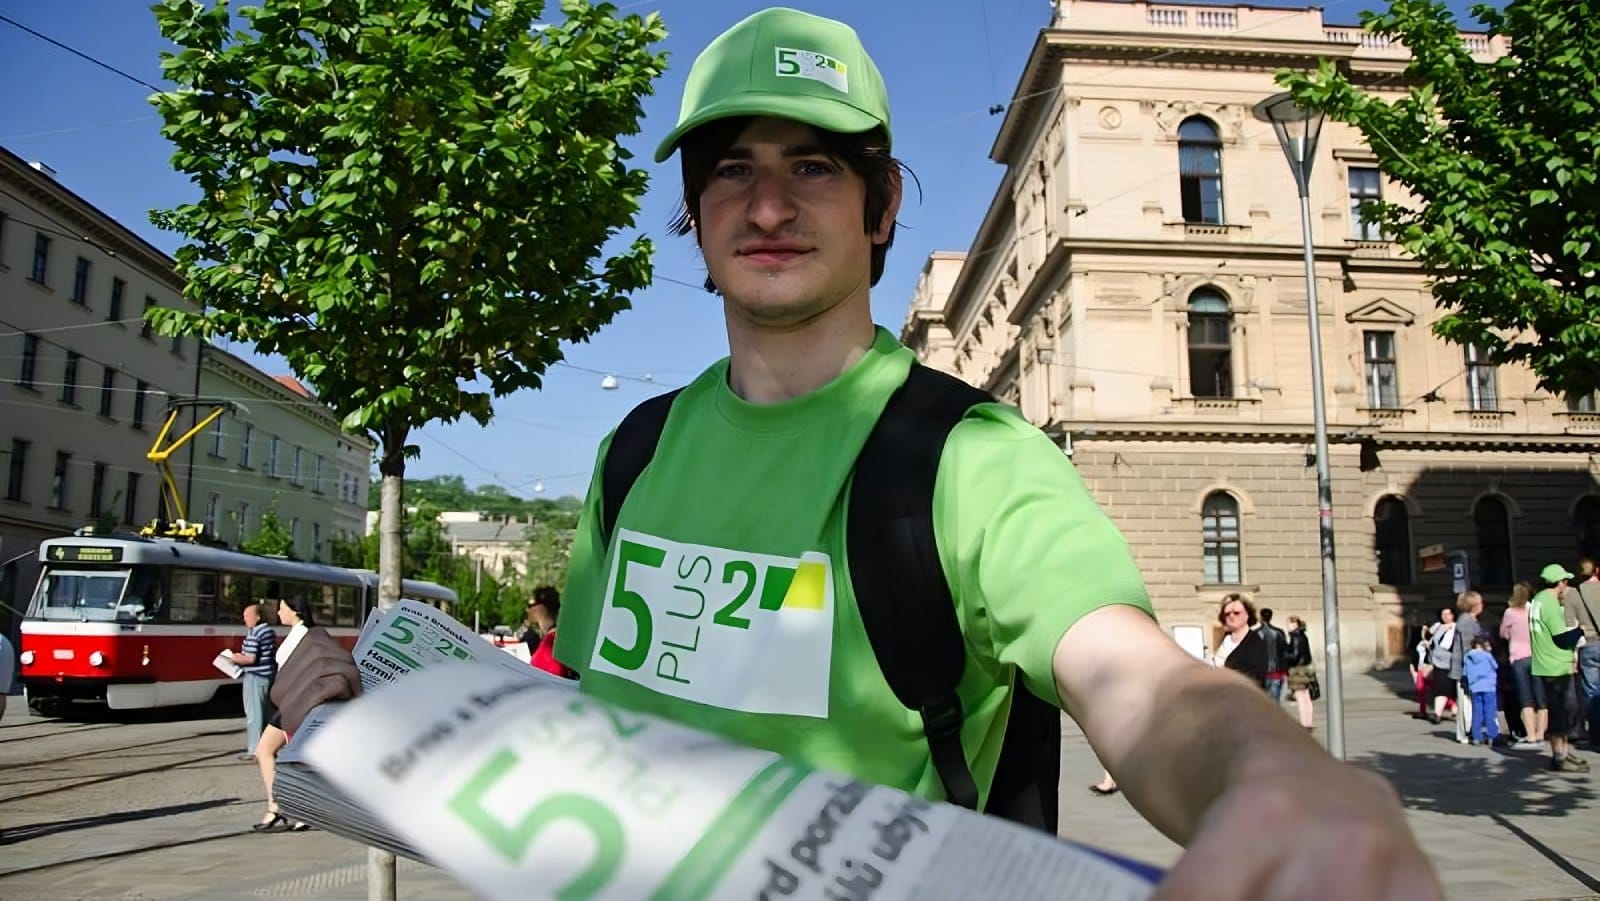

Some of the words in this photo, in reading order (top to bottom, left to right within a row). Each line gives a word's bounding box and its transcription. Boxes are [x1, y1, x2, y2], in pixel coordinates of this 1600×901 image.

[778, 50, 800, 75] 5
[815, 54, 826, 69] 2
[381, 615, 421, 645] 5
[433, 638, 450, 658] 2
[599, 539, 667, 671] 5
[656, 554, 712, 685] PLUS
[713, 560, 757, 630] 2
[448, 746, 628, 901] 5
